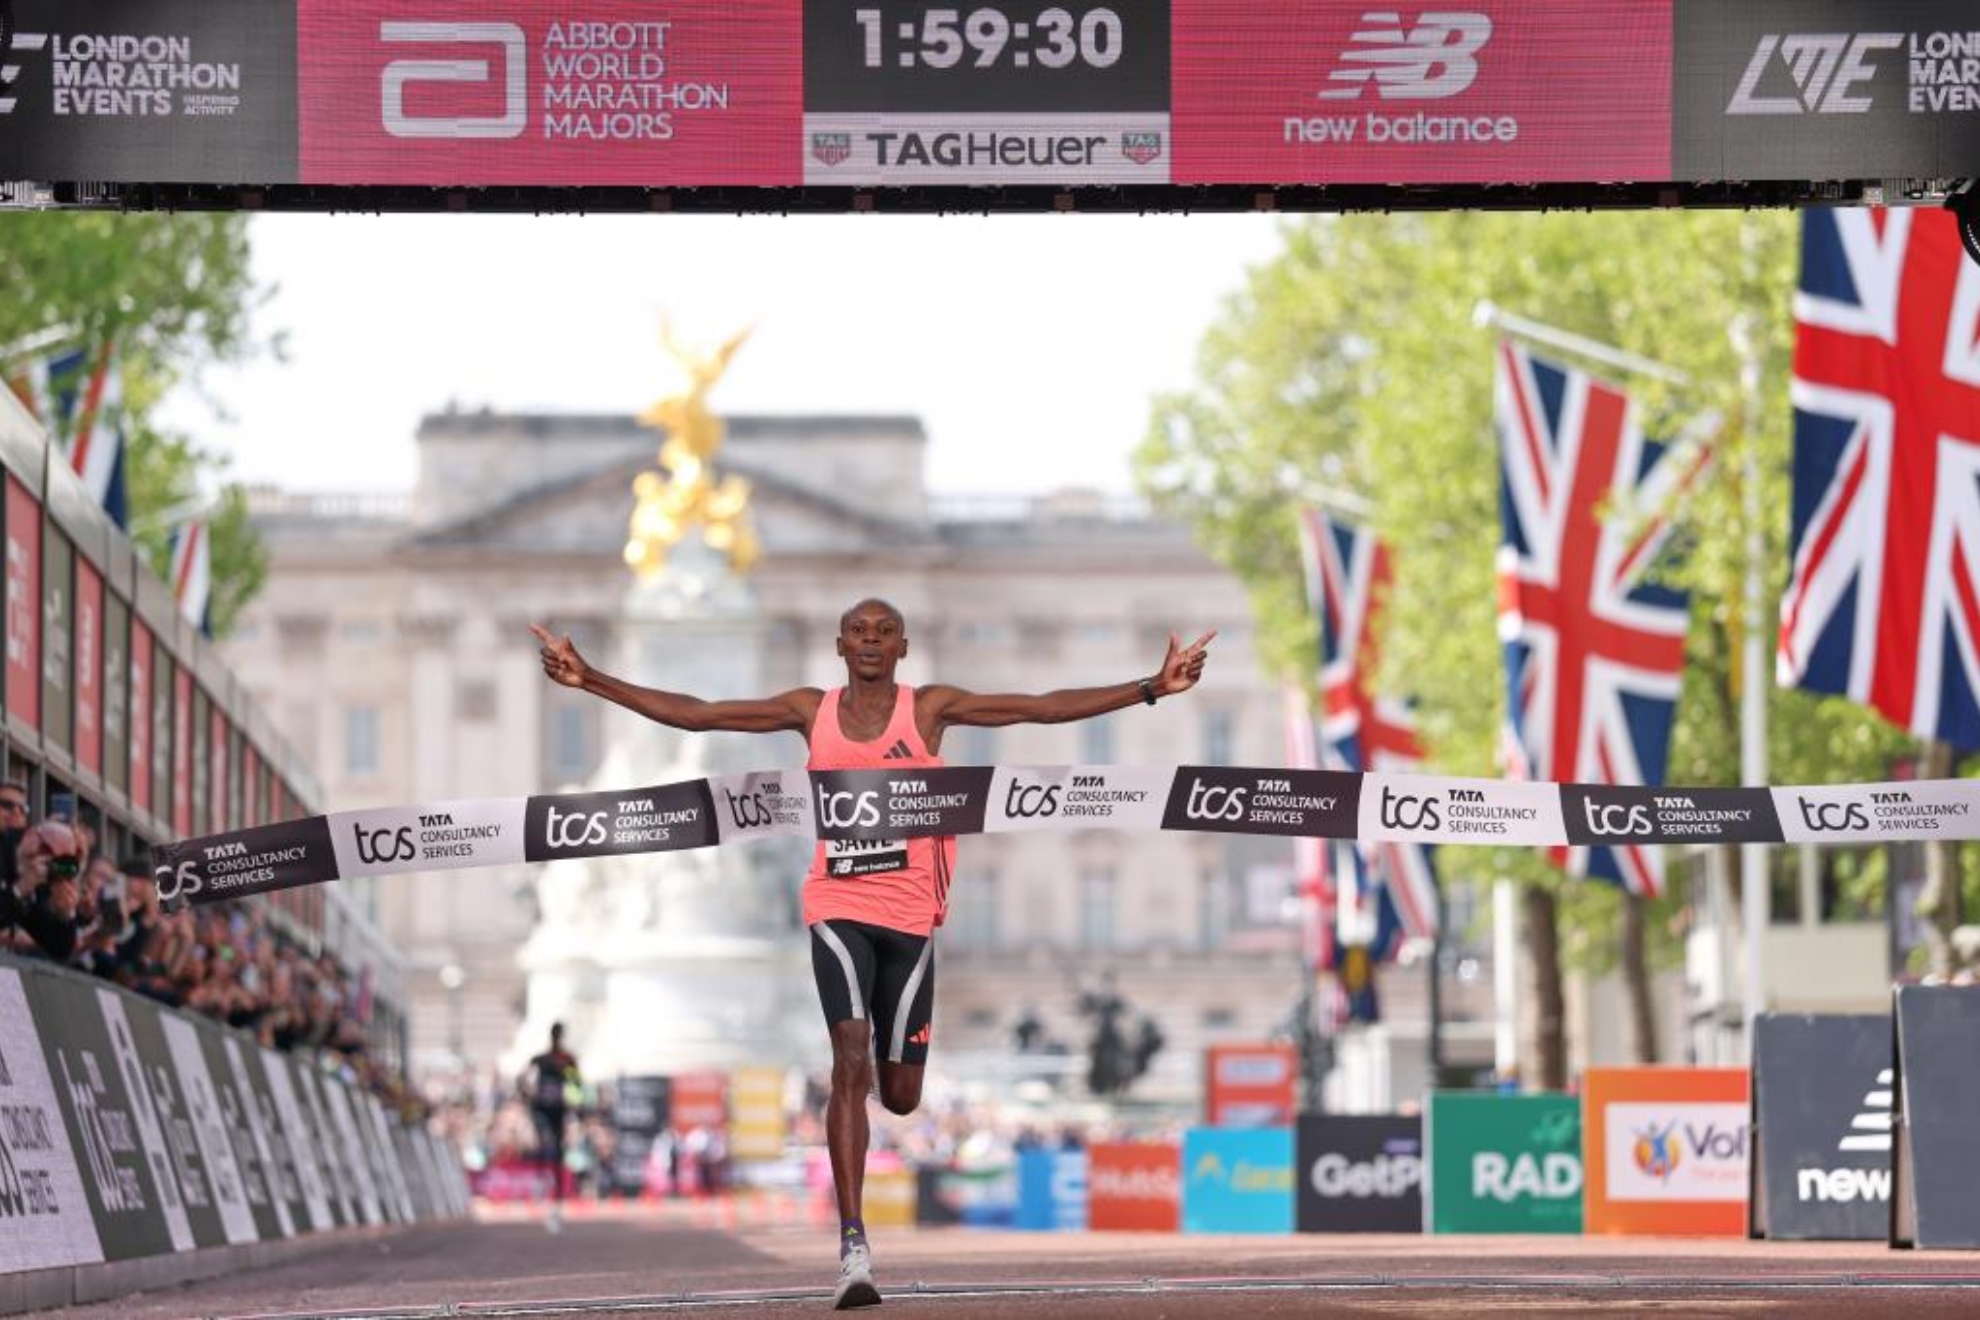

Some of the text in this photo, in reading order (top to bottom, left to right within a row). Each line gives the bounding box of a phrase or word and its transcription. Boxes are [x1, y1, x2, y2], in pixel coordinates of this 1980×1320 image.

[545, 22, 671, 49] ABBOTT
[856, 8, 1123, 68] 1:59:30
[53, 34, 191, 62] LONDON
[1909, 32, 1980, 59] LON
[53, 61, 240, 88] MARATHON
[543, 53, 665, 80] WORLD
[53, 88, 171, 115] EVENTS
[545, 83, 728, 109] MARATHON
[545, 112, 673, 139] MAJORS
[1284, 112, 1518, 142] new balance
[888, 780, 928, 794] TATA
[1072, 776, 1105, 787] TATA
[1256, 779, 1292, 792] TATA
[888, 793, 969, 810] CONSULTANCY
[1005, 777, 1062, 818] tcs
[1067, 791, 1147, 802] CONSULTANCY
[1186, 778, 1247, 821] tcs
[1252, 794, 1338, 811] CONSULTANCY
[1448, 789, 1485, 802] TATA
[1653, 797, 1696, 808] TATA
[1869, 792, 1913, 804] TATA
[617, 799, 654, 813] TATA
[725, 787, 772, 828] tcs
[819, 783, 880, 828] tcs
[1061, 805, 1114, 817] SERVICES
[1380, 785, 1441, 831] tcs
[1448, 805, 1537, 820] CONSULTANCY
[1583, 795, 1653, 835] tcs
[1797, 795, 1870, 831] tcs
[1874, 803, 1969, 817] CONSULTANCY
[418, 814, 454, 827] TATA
[615, 808, 699, 829] CONSULTANCY
[889, 811, 941, 827] SERVICES
[1249, 810, 1304, 824] SERVICES
[1657, 809, 1752, 822] CONSULTANCY
[1878, 818, 1940, 831] SERVICES
[420, 825, 501, 843] CONSULTANCY
[546, 806, 608, 848] tcs
[613, 828, 670, 844] SERVICES
[1448, 820, 1508, 834] SERVICES
[1661, 823, 1723, 835] SERVICES
[204, 841, 248, 860] TATA
[354, 822, 416, 864] tcs
[422, 843, 474, 859] SERVICES
[207, 846, 307, 874] CONSULTANCY
[211, 867, 275, 889] SERVICES
[1797, 1168, 1891, 1201] new
